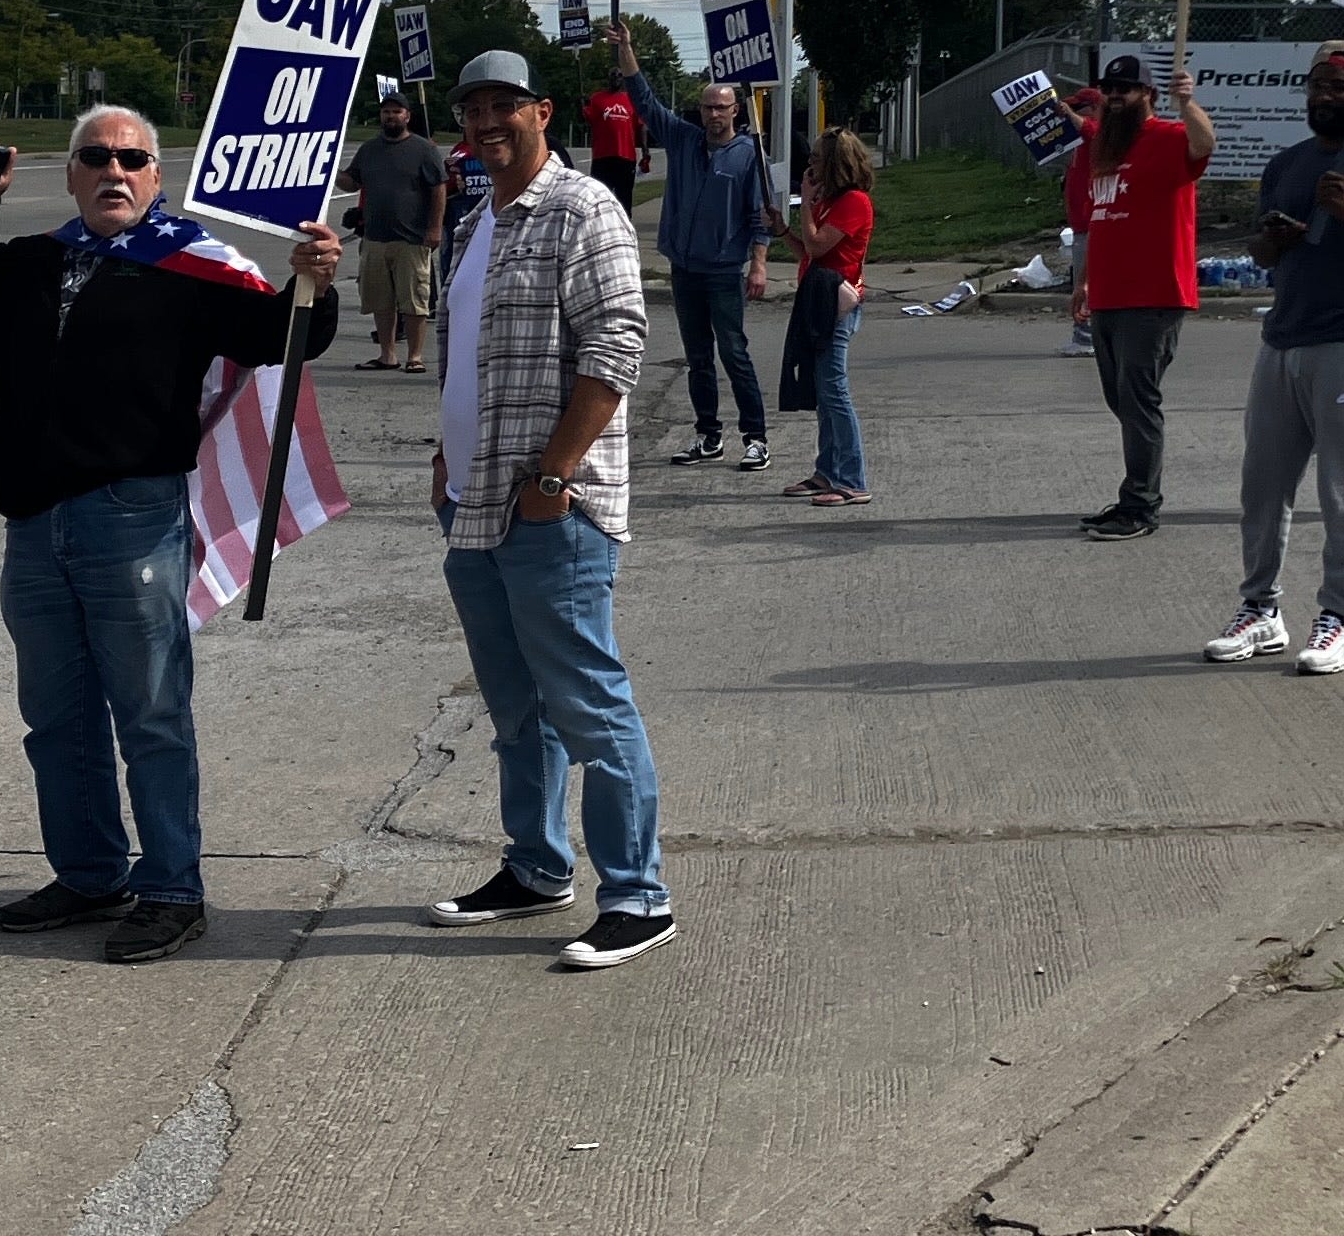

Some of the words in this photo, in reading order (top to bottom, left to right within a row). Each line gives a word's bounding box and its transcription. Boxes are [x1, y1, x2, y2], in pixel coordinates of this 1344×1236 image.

[396, 12, 425, 32] UAW
[564, 18, 585, 28] END
[724, 8, 749, 42] ON
[713, 32, 772, 79] STRIKE
[1001, 75, 1041, 106] UAW
[1196, 68, 1308, 87] Precisio
[264, 66, 323, 126] ON
[1024, 124, 1050, 144] FAIR
[1047, 115, 1066, 130] PA
[1025, 107, 1054, 129] COLA
[1038, 126, 1064, 147] NOW
[202, 130, 338, 194] STRIKE
